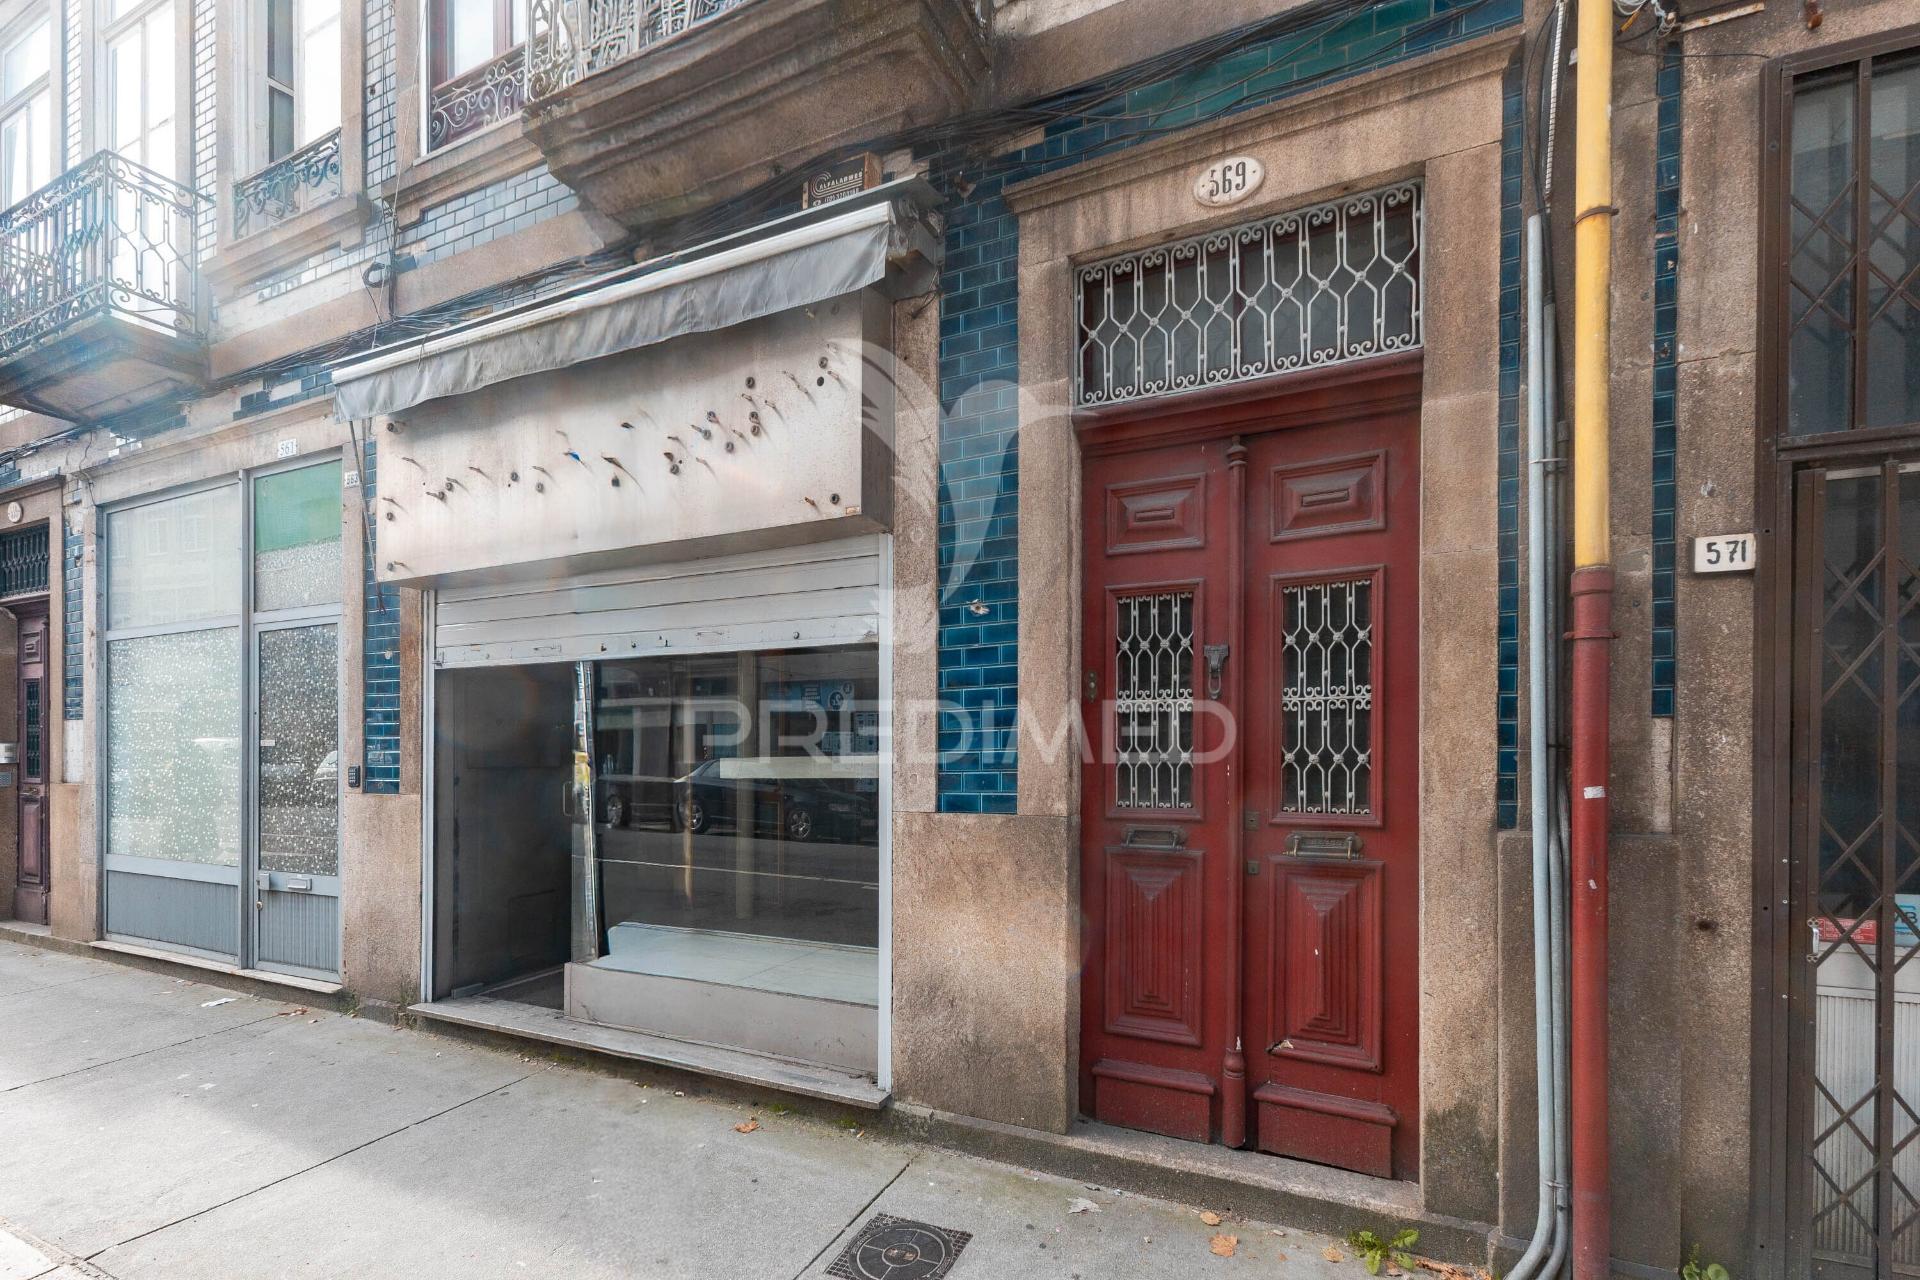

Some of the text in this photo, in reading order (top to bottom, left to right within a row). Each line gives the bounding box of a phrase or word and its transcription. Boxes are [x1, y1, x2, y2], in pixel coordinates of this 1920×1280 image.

[1209, 162, 1246, 197] 569
[280, 441, 294, 456] 561
[1706, 539, 1747, 564] 571
